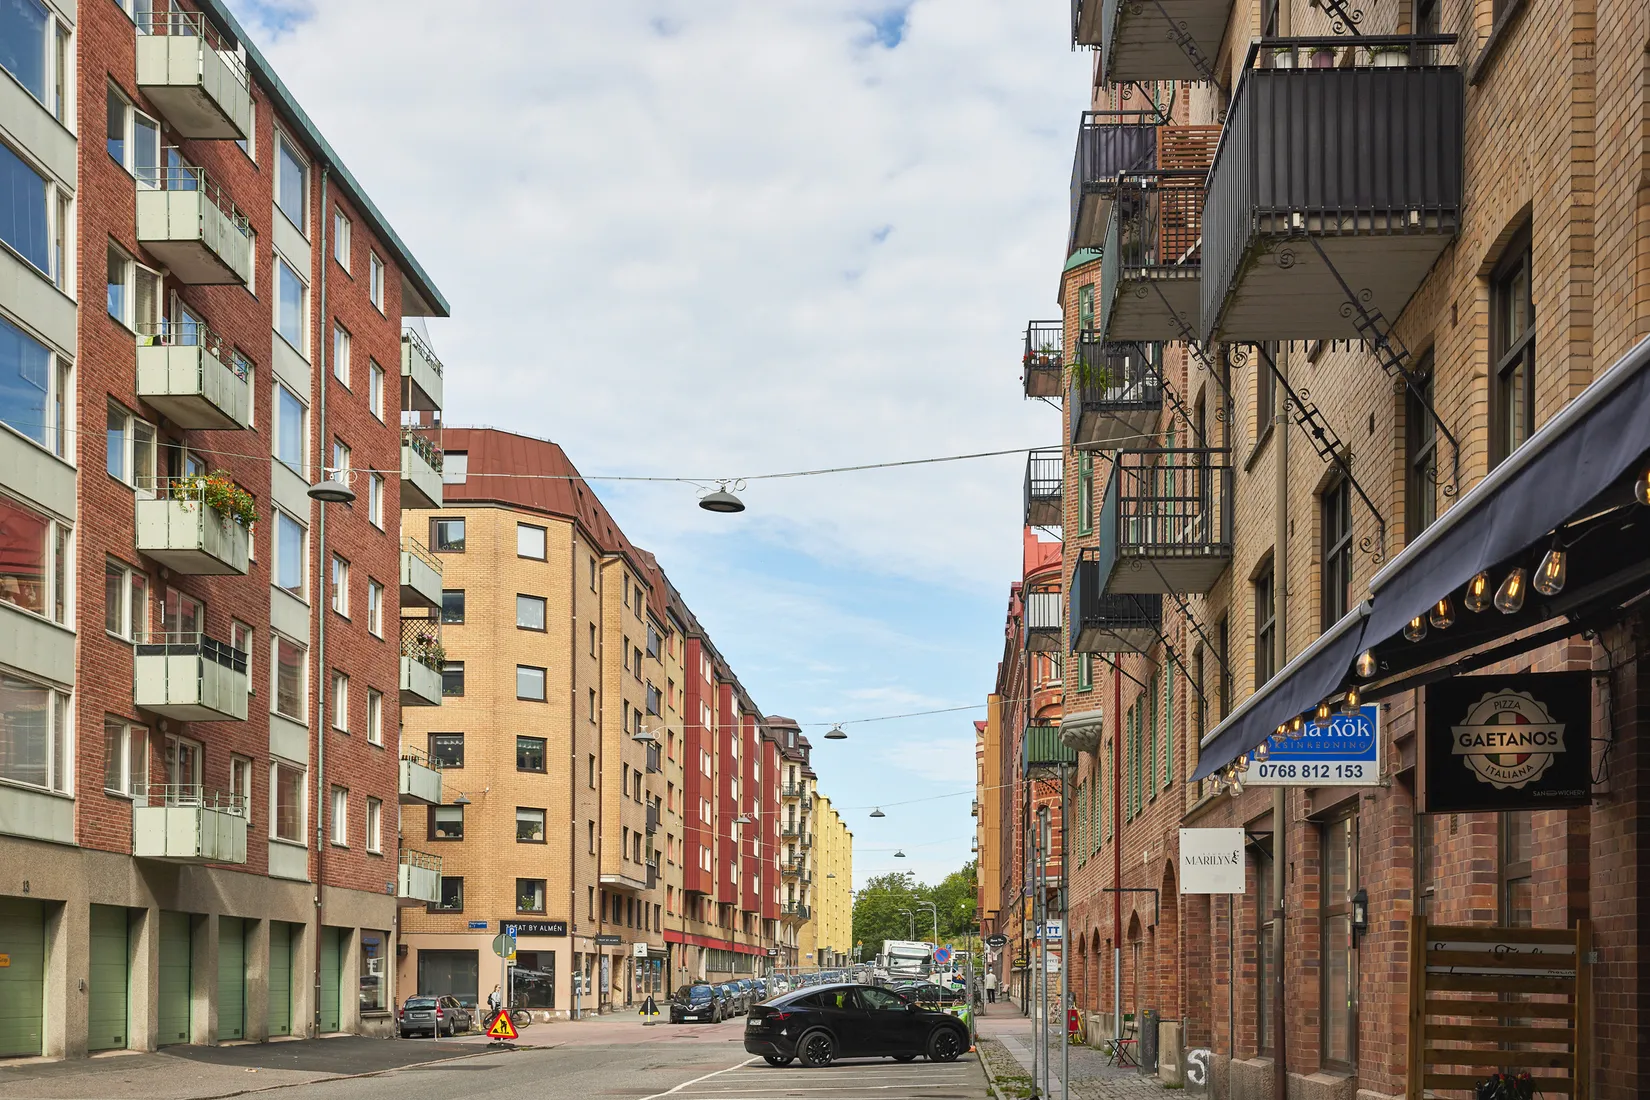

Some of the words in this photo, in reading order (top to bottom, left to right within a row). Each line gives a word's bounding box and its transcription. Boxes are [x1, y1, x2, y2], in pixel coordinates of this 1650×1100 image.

[1493, 700, 1522, 711] PIZZA
[1327, 718, 1370, 737] Kök
[1459, 731, 1558, 747] GAETANOS
[1259, 764, 1297, 778] 0768
[1301, 764, 1330, 778] 812
[1335, 764, 1363, 778] 153
[1485, 764, 1534, 779] ITALIANA
[1185, 855, 1231, 865] MARILYN
[22, 880, 30, 893] 13
[509, 927, 515, 936] P
[528, 924, 538, 932] BY
[539, 924, 563, 932] ALMÉN
